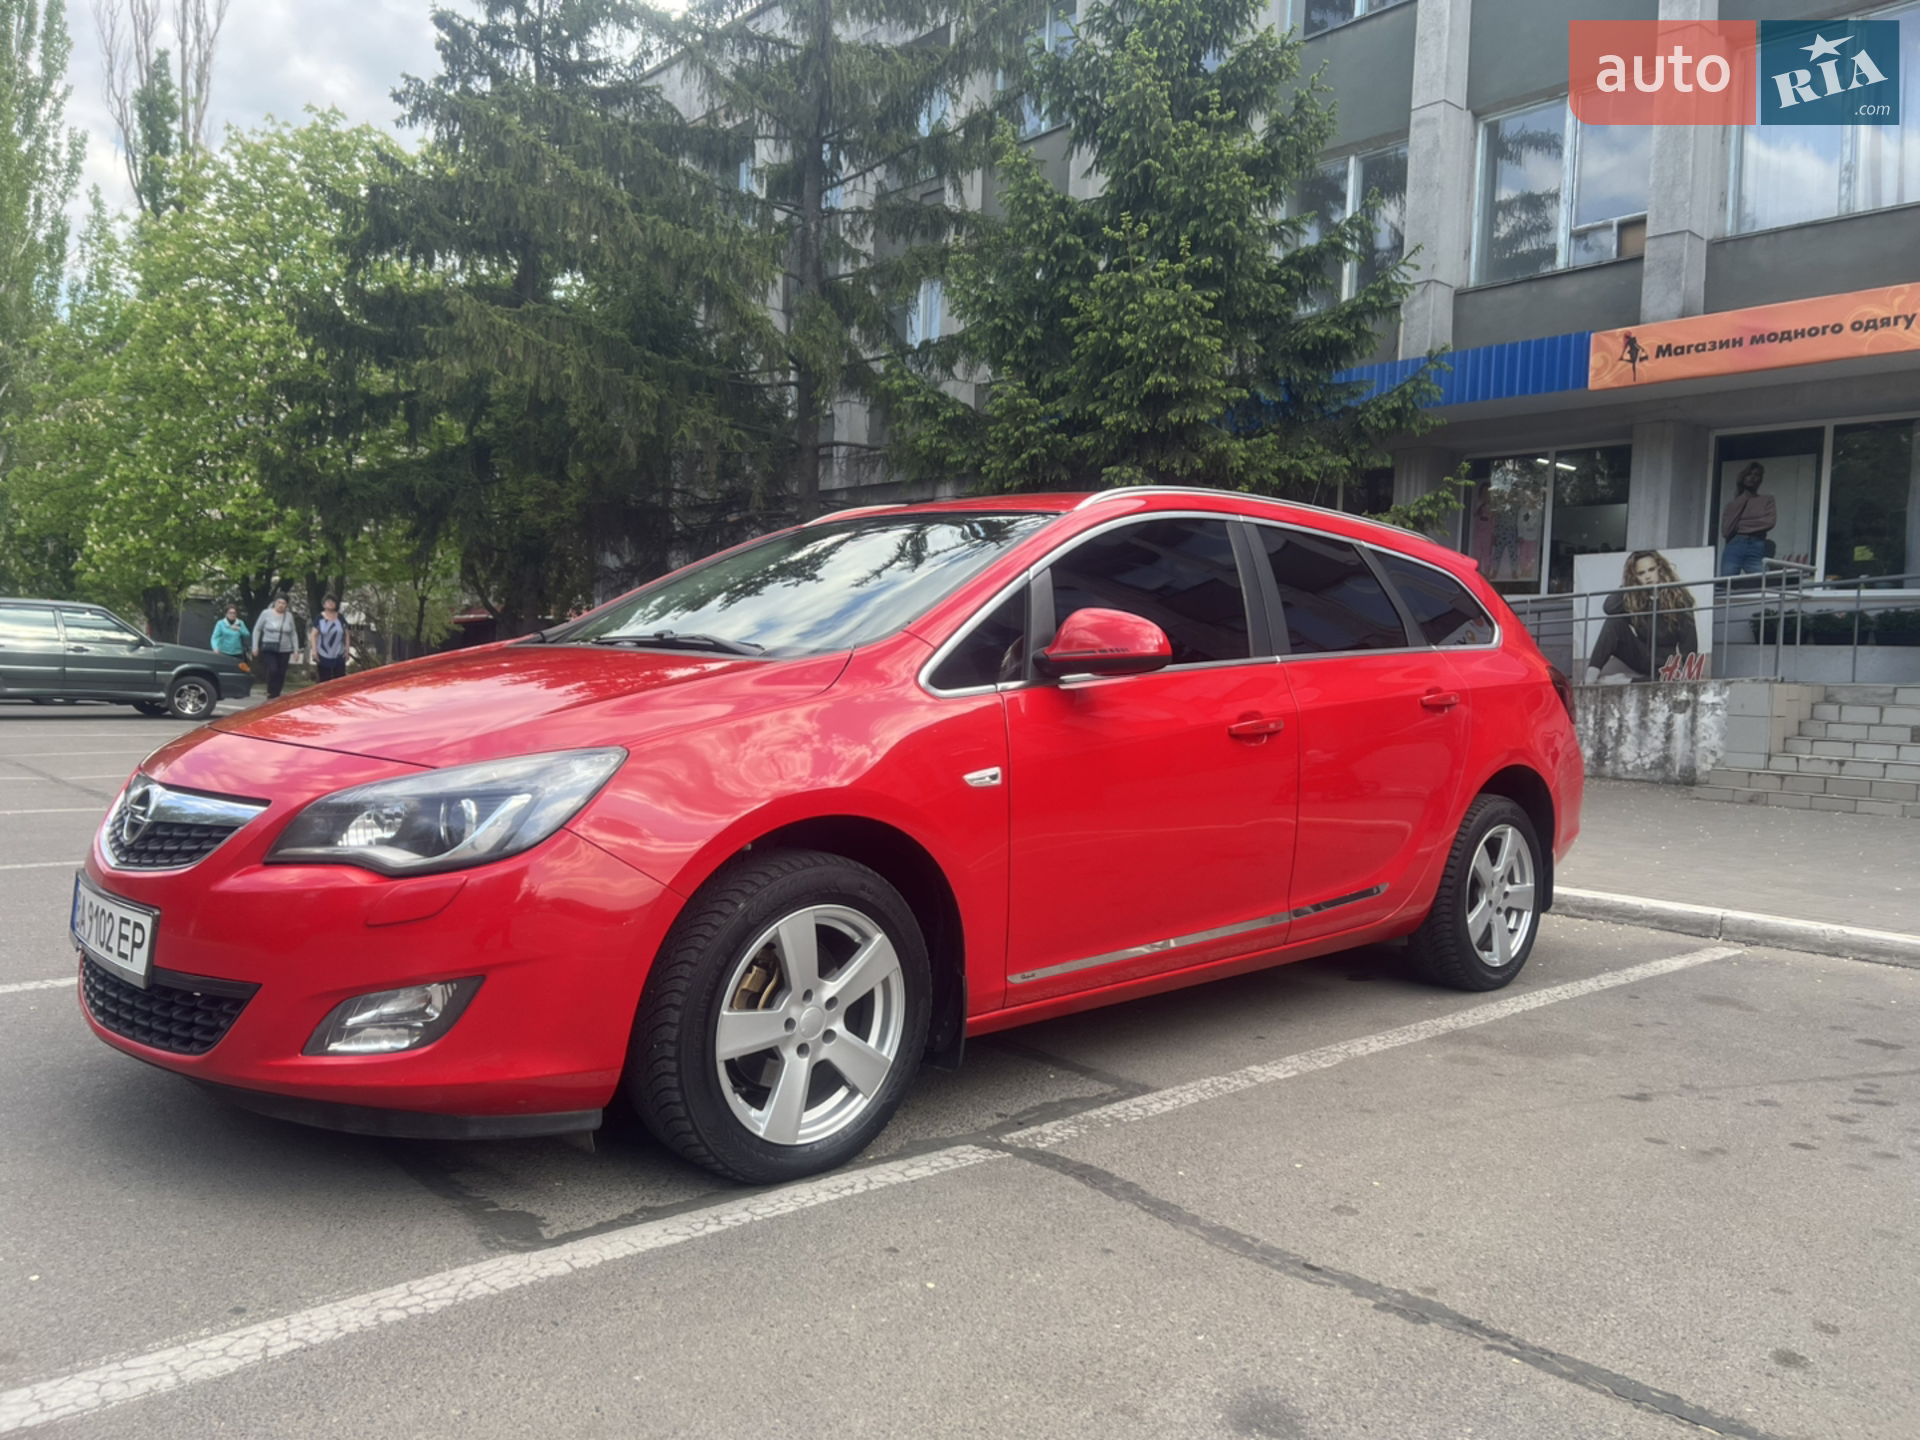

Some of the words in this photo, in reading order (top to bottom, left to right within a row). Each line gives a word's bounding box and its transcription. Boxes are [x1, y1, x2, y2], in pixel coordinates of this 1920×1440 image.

[1654, 335, 1744, 359] Магазин
[1749, 320, 1844, 347] модного
[1850, 312, 1917, 334] одягу
[117, 915, 145, 963] EP
